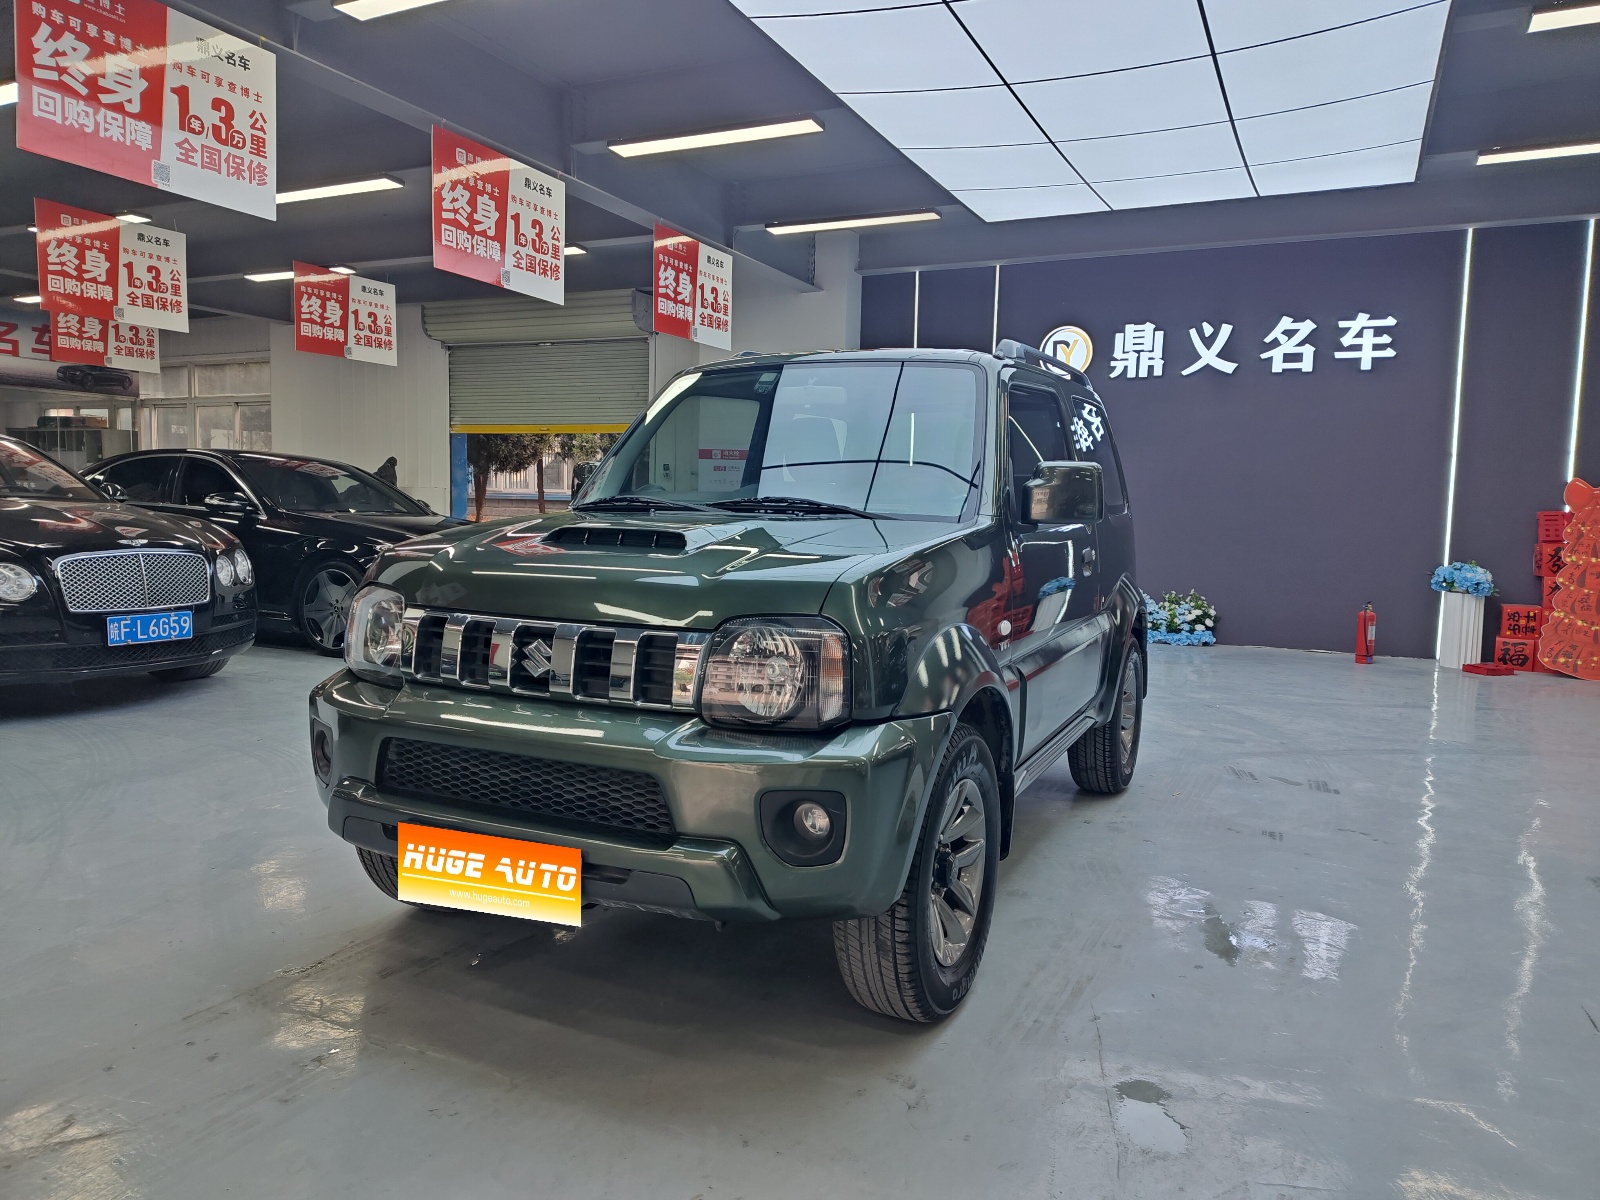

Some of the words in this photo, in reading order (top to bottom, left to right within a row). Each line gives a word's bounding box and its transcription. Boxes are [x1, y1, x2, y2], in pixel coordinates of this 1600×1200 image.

[88, 0, 125, 16] 博士
[32, 1, 149, 59] 购车可享查博士
[196, 36, 250, 71] 鼎义名车
[31, 22, 148, 114] 终身
[172, 60, 262, 103] 购车可享查博士
[32, 85, 153, 151] 回购保障
[175, 137, 268, 186] 全国保修
[523, 177, 553, 198] 鼎义名车
[441, 181, 500, 236] 终身
[510, 194, 559, 220] 购车可享查博士
[137, 232, 171, 247] 鼎义名车
[441, 223, 501, 262] 回购保障
[46, 239, 111, 282] 终身
[122, 247, 178, 265] 购车可享查博士
[512, 250, 561, 281] 全国保修
[47, 275, 114, 302] 回购保障
[658, 263, 693, 303] 终身
[126, 291, 183, 314] 全国保修
[300, 294, 343, 326] 终身
[658, 297, 693, 322] 回购保障
[57, 312, 103, 340] 终身
[300, 322, 345, 343] 回购保障
[699, 312, 729, 333] 全国保修
[57, 335, 105, 353] 回购保障
[114, 344, 156, 360] 全国保修
[353, 333, 393, 351] 全国保修
[1109, 312, 1398, 379] 鼎义名车
[1497, 641, 1529, 667] 福
